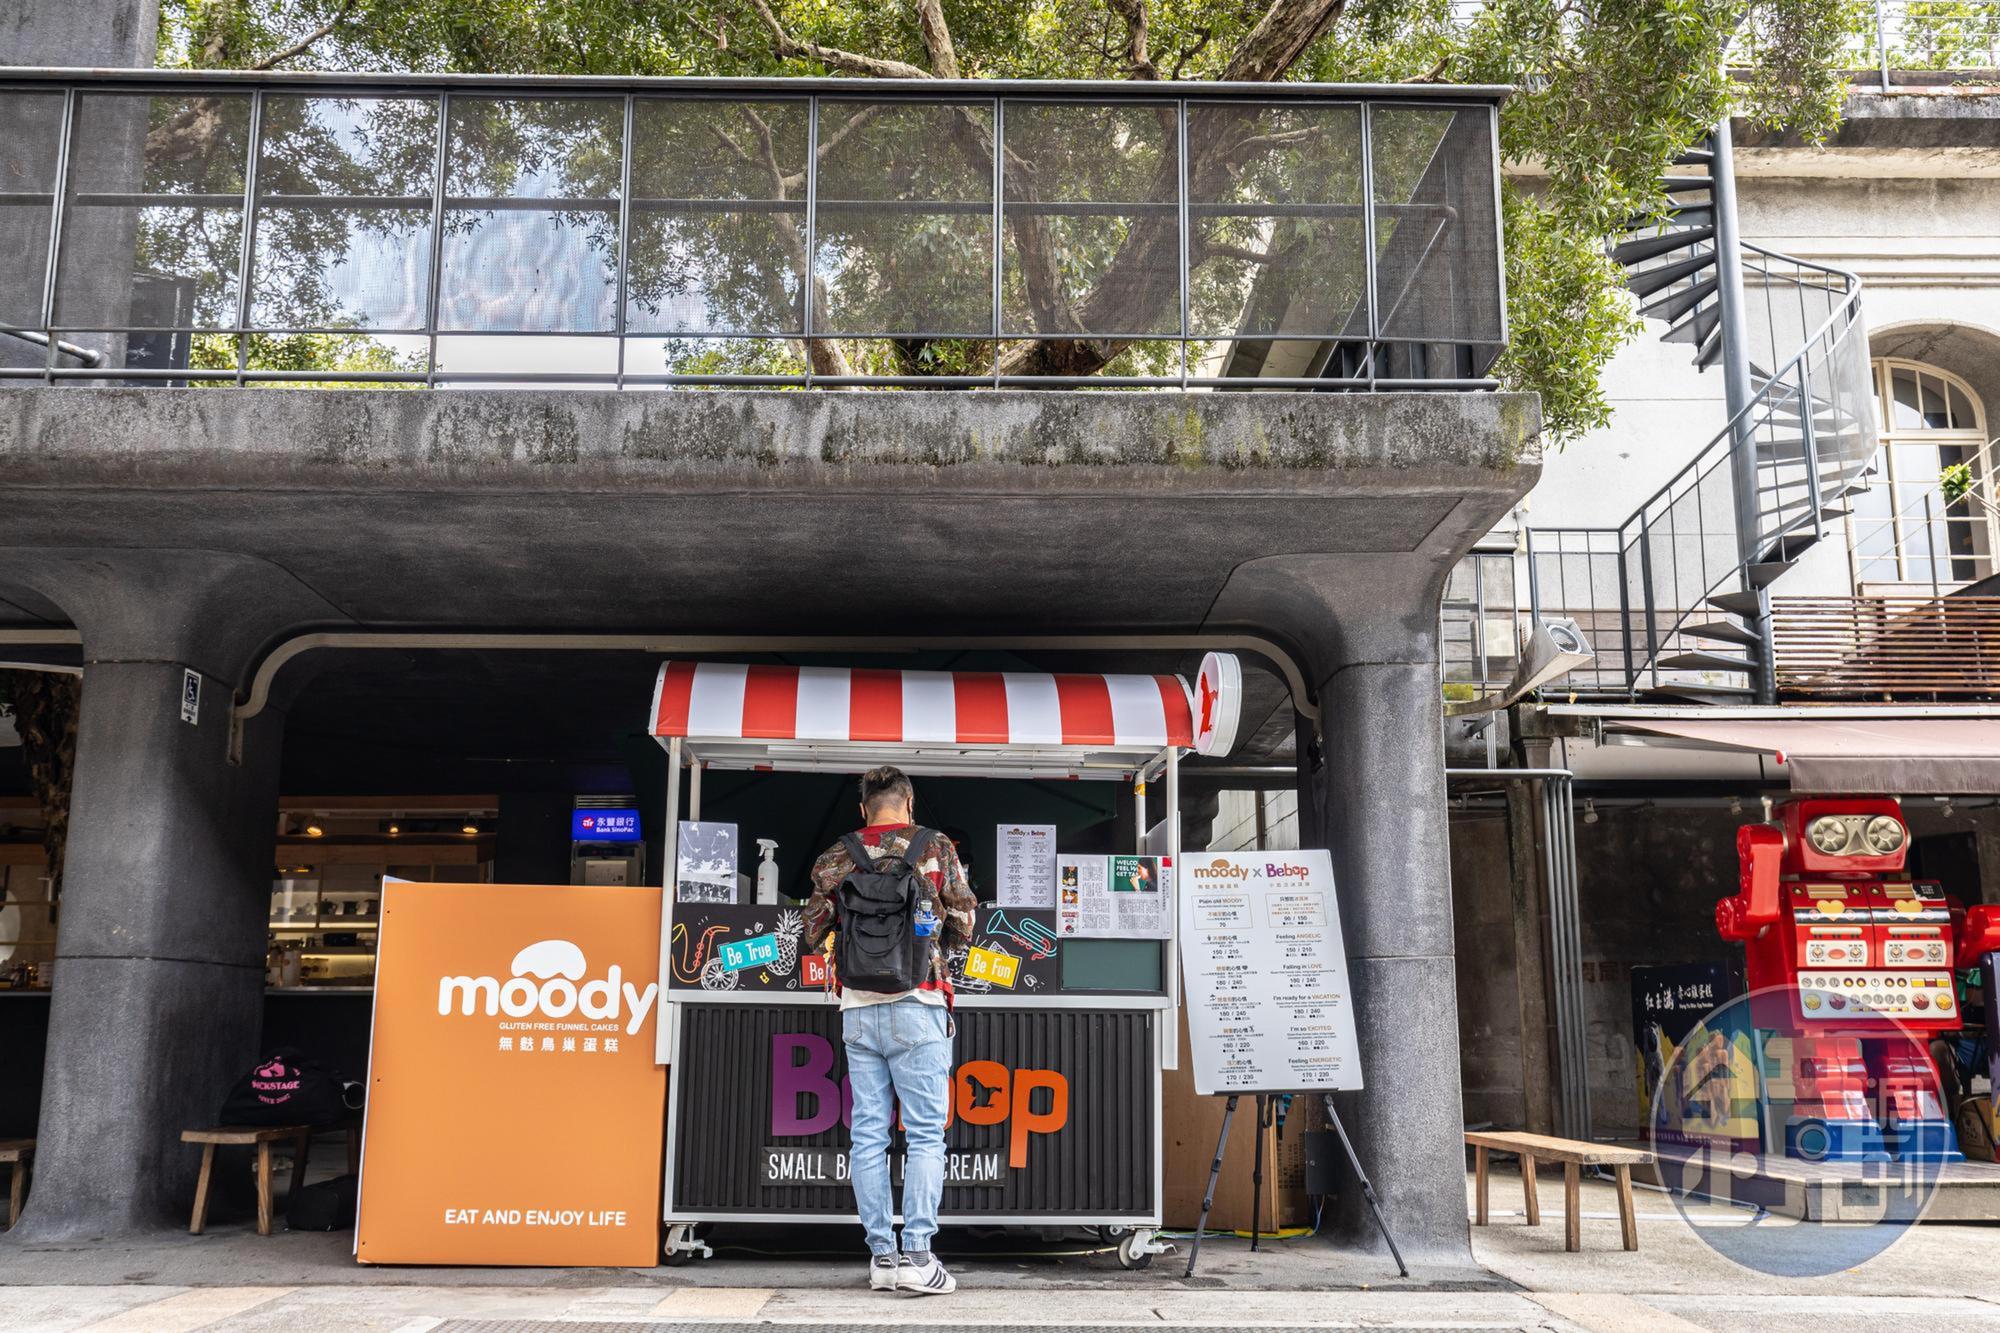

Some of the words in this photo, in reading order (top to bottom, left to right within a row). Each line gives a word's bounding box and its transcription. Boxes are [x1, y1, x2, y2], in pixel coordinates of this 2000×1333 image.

[597, 817, 634, 826] 永豐銀行
[1194, 864, 1248, 881] moody
[1266, 863, 1309, 880] Bebop
[727, 947, 742, 966] Be
[746, 942, 772, 961] True
[810, 962, 824, 981] Be
[972, 953, 986, 973] Be
[992, 958, 1011, 978] Fun
[438, 964, 658, 1035] moody
[499, 1022, 532, 1030] GLUTEN
[533, 1022, 554, 1031] FREE
[556, 1023, 589, 1032] FUNNEL
[591, 1023, 619, 1032] CAKES
[772, 1032, 1068, 1168] Bop
[768, 1153, 826, 1180] SMALL
[445, 1209, 478, 1224] EAT
[482, 1209, 521, 1224] AND
[526, 1210, 585, 1226] ENJOY
[589, 1211, 627, 1226] LIFE
